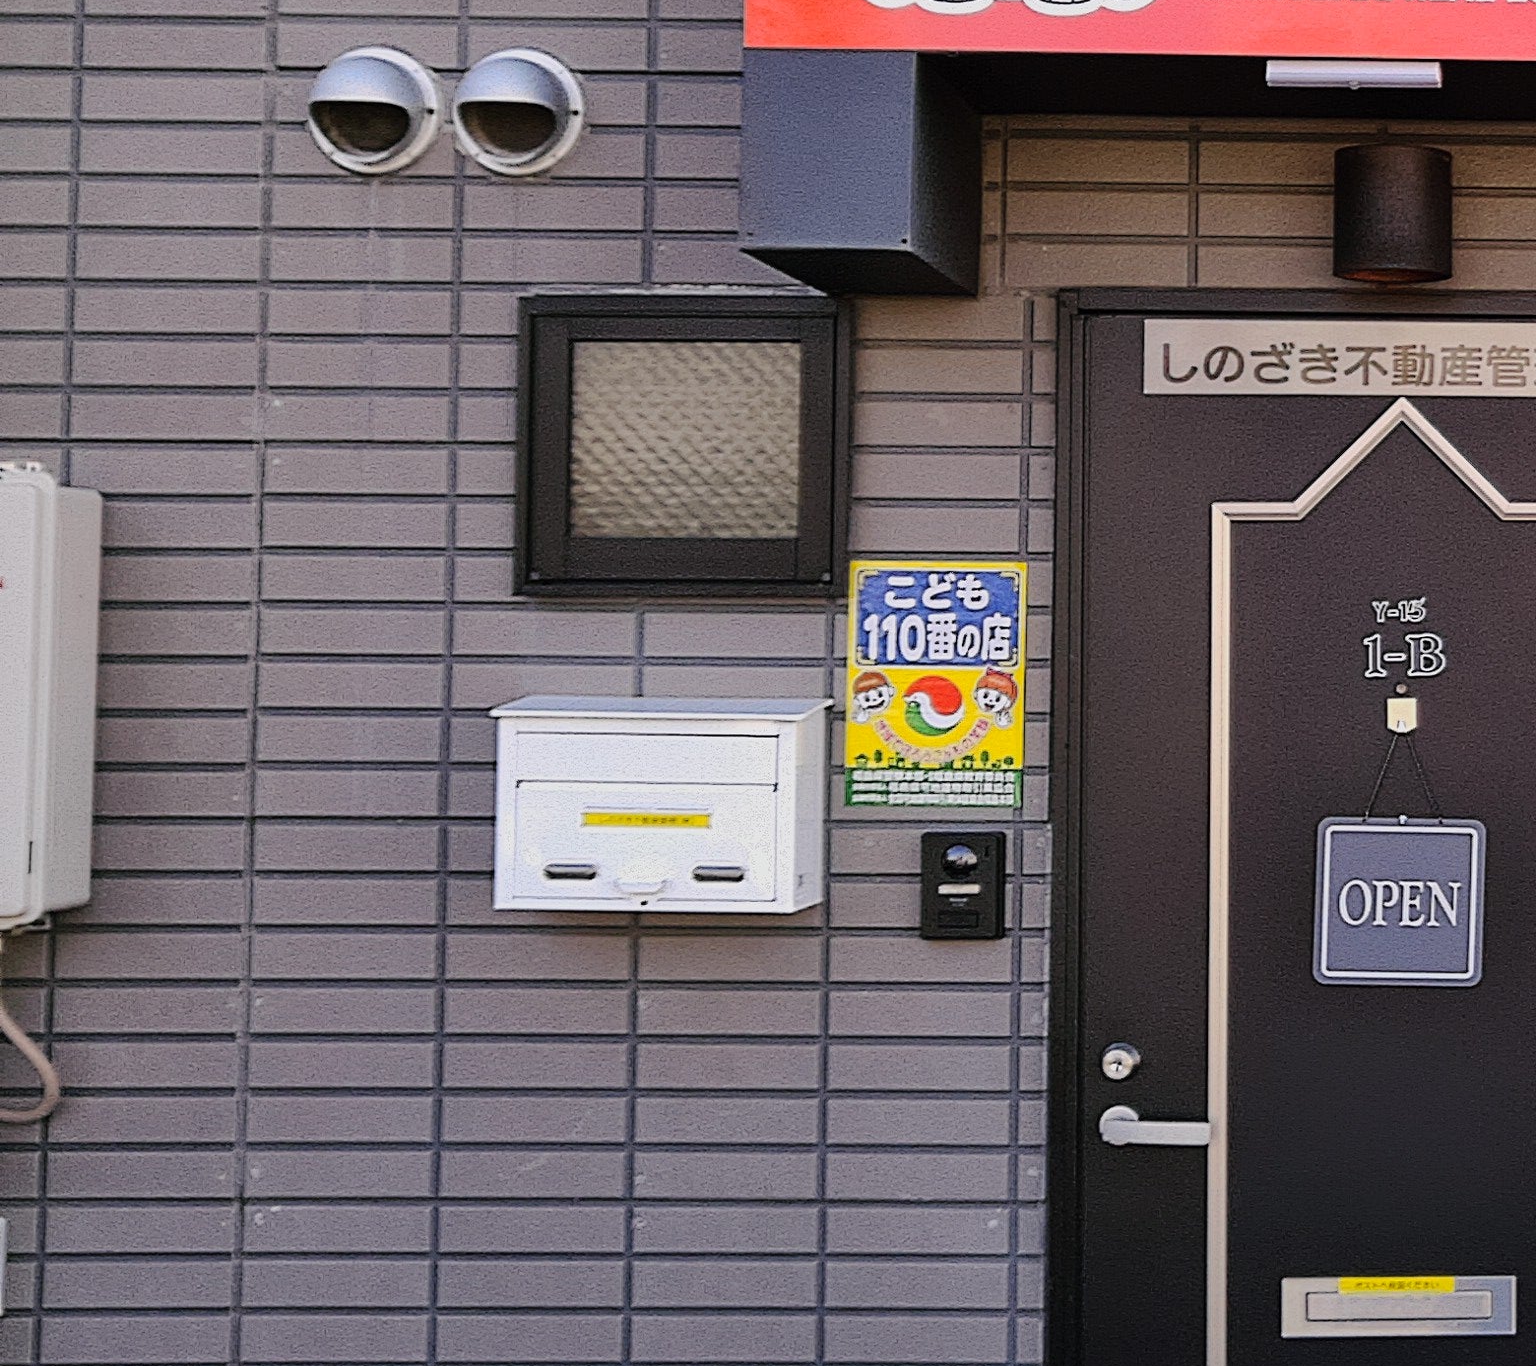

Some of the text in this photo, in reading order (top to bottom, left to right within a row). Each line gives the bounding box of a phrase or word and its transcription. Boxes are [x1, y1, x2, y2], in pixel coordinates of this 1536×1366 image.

[884, 572, 990, 610] こども
[862, 612, 1012, 662] 110番の店
[1363, 632, 1446, 678] 1-B
[1338, 879, 1461, 928] OPEN
